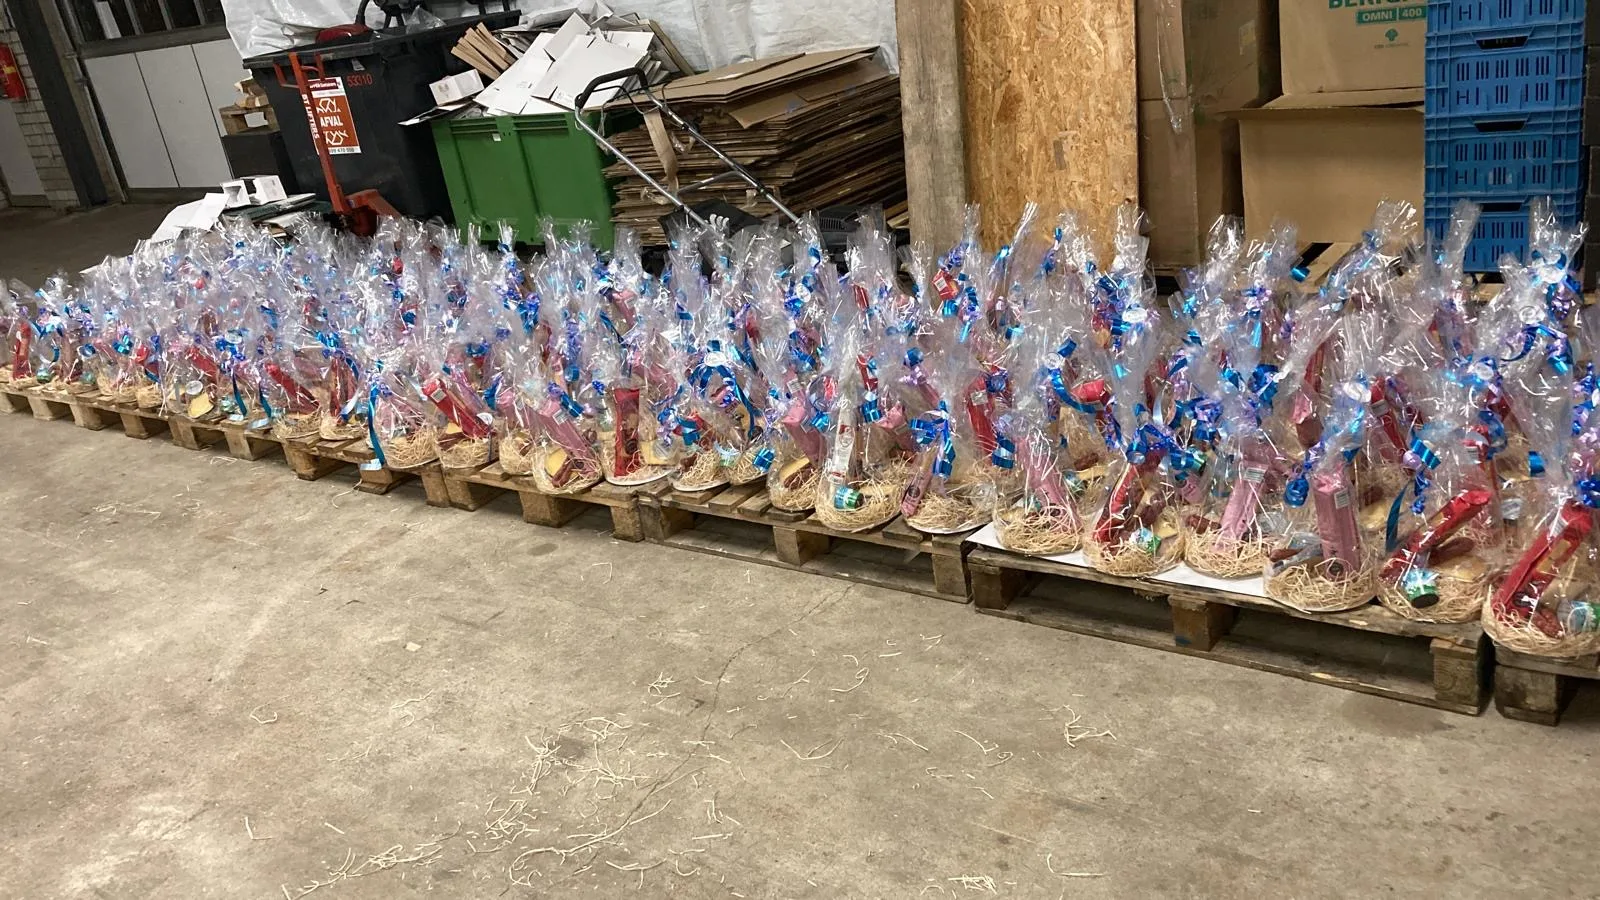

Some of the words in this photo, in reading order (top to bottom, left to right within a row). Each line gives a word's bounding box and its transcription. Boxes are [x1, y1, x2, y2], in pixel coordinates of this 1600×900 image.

[1362, 10, 1392, 21] OMNI
[1402, 8, 1422, 17] 400
[305, 106, 320, 139] LIFTERS
[320, 115, 344, 127] AFVAL
